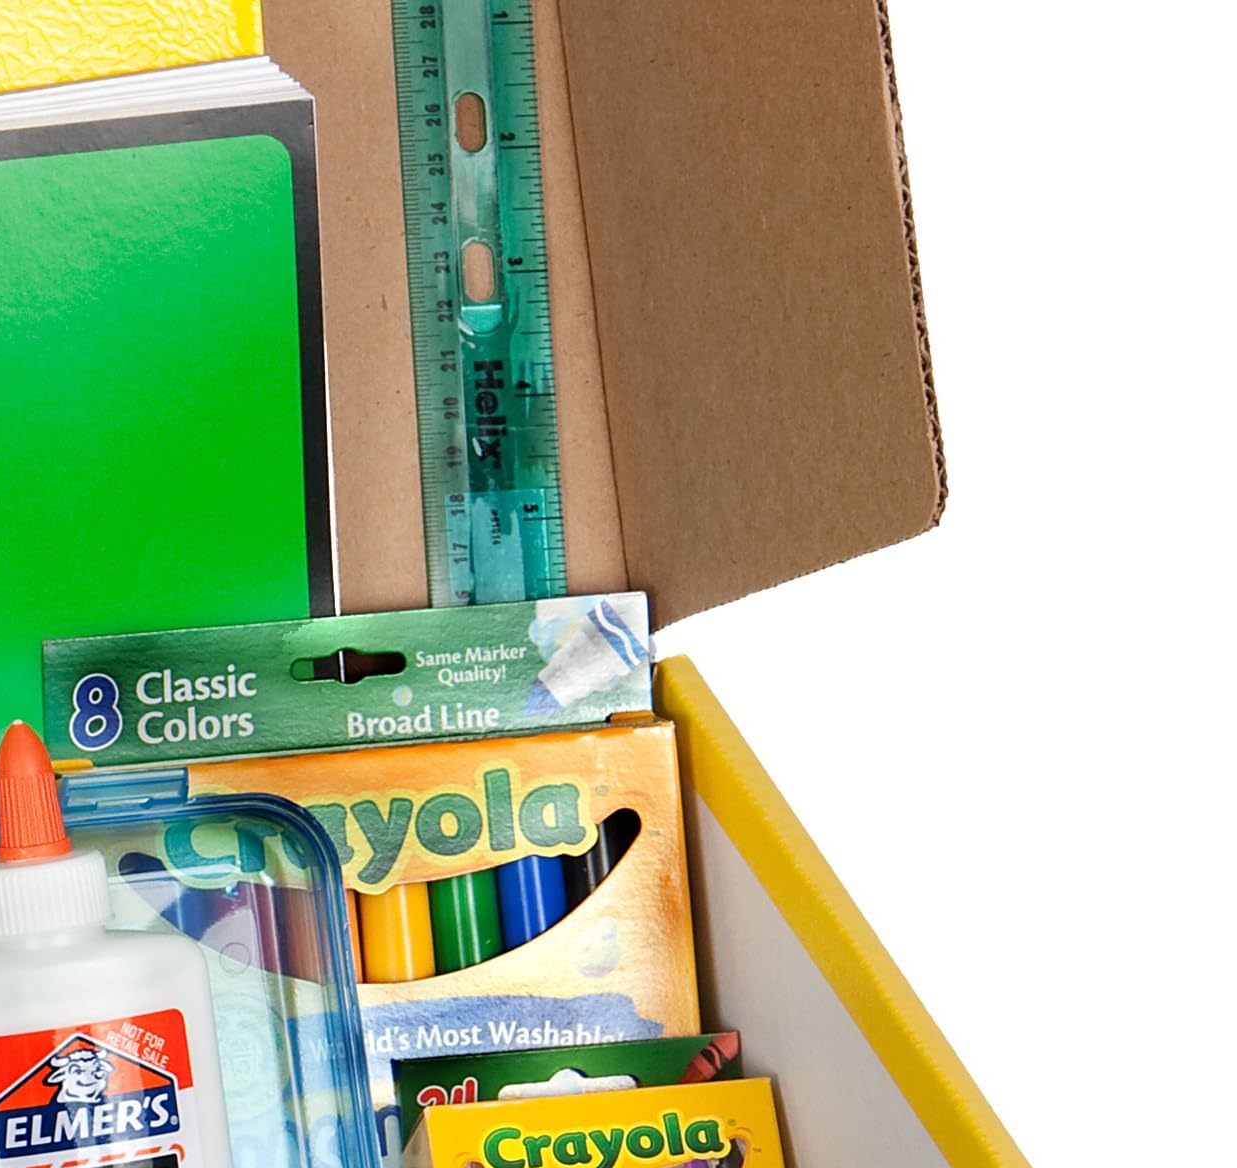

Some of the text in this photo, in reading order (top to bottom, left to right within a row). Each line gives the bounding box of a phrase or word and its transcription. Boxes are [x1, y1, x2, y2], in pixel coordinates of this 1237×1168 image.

[420, 6, 436, 29] 28
[422, 56, 439, 78] 27
[425, 103, 442, 127] 26
[427, 153, 445, 176] 25
[431, 202, 448, 225] 24
[434, 251, 450, 274] 23
[508, 257, 523, 266] 3
[437, 300, 454, 323] 22
[441, 350, 457, 372] 21
[443, 397, 459, 419] 20
[474, 360, 507, 470] Helix
[445, 445, 462, 468] 19
[449, 493, 466, 516] 18
[523, 504, 539, 513] 5
[453, 543, 468, 565] 17
[415, 643, 527, 667] Same Marker
[136, 665, 257, 705] Classic
[438, 664, 506, 687] Quality!
[71, 674, 121, 750] 8
[348, 703, 500, 739] Broad Line
[137, 707, 254, 745] Colors
[164, 768, 586, 885] Crayola
[122, 1022, 165, 1051] NOT FOR
[417, 1022, 481, 1049] Most
[106, 1031, 169, 1069] RETAIL SALE
[5, 1093, 169, 1149] ELMER'S
